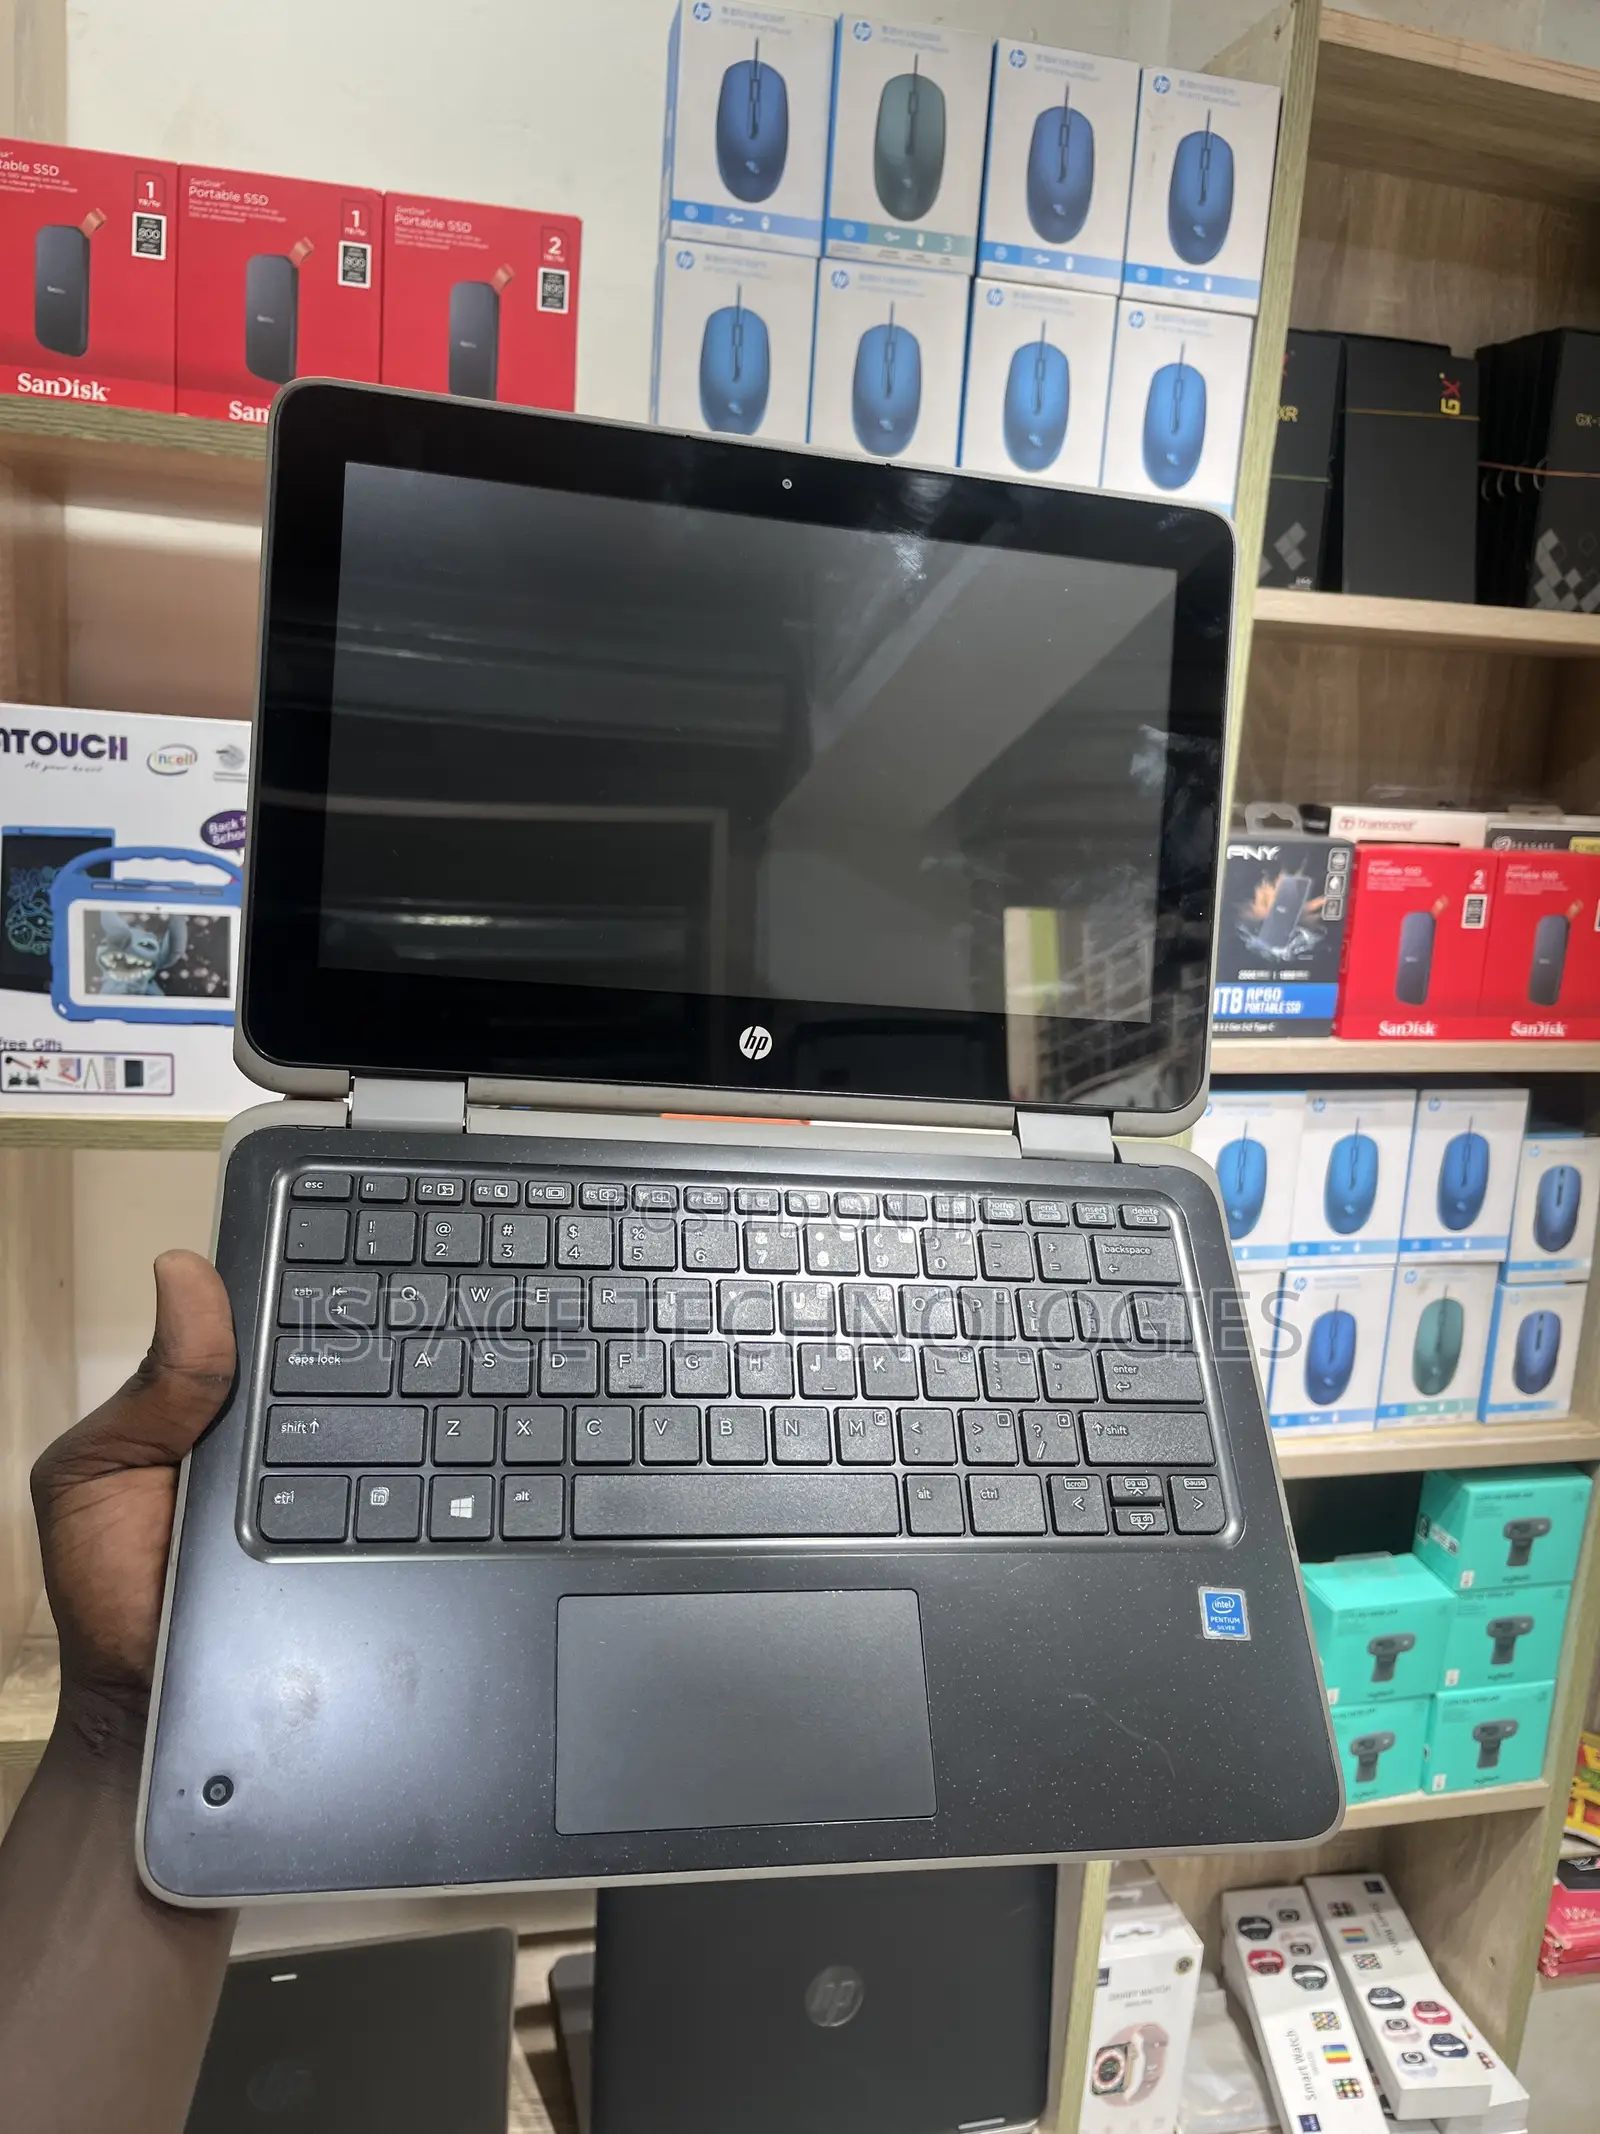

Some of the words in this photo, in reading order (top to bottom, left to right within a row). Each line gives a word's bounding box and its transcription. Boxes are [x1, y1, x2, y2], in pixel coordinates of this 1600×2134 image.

[33, 163, 60, 177] SSD
[145, 181, 155, 199] 1
[188, 186, 241, 201] Portable
[243, 193, 269, 206] SSD
[351, 210, 361, 228] 1
[394, 213, 445, 230] Portable
[447, 220, 471, 233] SSD
[548, 236, 562, 255] 2
[17, 372, 110, 402] SanDisk
[209, 819, 238, 835] Back
[1227, 845, 1280, 861] PNY
[1378, 1020, 1437, 1037] SanDisk
[1510, 1021, 1567, 1037] SanDisk
[739, 1025, 772, 1060] hp
[305, 1181, 323, 1189] esc
[422, 1185, 433, 1194] f2
[477, 1186, 489, 1195] f3
[532, 1188, 543, 1198] f4
[1081, 1206, 1107, 1214] insert
[1132, 1207, 1159, 1216] delete
[435, 1222, 452, 1236] @
[502, 1224, 514, 1236] #
[567, 1224, 579, 1239] $
[632, 1227, 645, 1240] %
[368, 1242, 376, 1255] 1
[435, 1243, 447, 1256] 2
[502, 1244, 514, 1258] 3
[568, 1246, 580, 1259] 4
[633, 1247, 643, 1260] 5
[695, 1249, 706, 1262] 6
[1103, 1245, 1151, 1256] backspace
[294, 1288, 312, 1297] tab
[401, 1287, 417, 1301] Q
[471, 1288, 490, 1302] W
[537, 1289, 549, 1303] E
[602, 1290, 616, 1303] R
[666, 1291, 678, 1304] T
[972, 1299, 982, 1313] P
[288, 1356, 314, 1366] caps
[317, 1354, 341, 1364] lock
[414, 1354, 431, 1368] A
[483, 1353, 497, 1368] S
[552, 1354, 566, 1368] D
[619, 1354, 631, 1369] F
[685, 1355, 700, 1369] G
[749, 1354, 763, 1371] H
[809, 1355, 822, 1372] J
[873, 1356, 887, 1373] K
[933, 1358, 945, 1374] L
[1113, 1365, 1138, 1374] enter
[281, 1422, 307, 1433] shift
[446, 1420, 460, 1436] Z
[516, 1420, 531, 1435] X
[586, 1420, 600, 1435] C
[654, 1420, 668, 1435] V
[720, 1420, 733, 1435] B
[784, 1420, 799, 1436] N
[850, 1420, 865, 1436] M
[1033, 1424, 1042, 1437] ?
[1106, 1425, 1128, 1436] shift
[1066, 1480, 1086, 1488] scroll
[274, 1491, 295, 1504] ctrl
[517, 1491, 530, 1501] alt
[917, 1488, 931, 1499] alt
[981, 1489, 999, 1499] ctrl
[1215, 1600, 1233, 1608] intel
[1210, 1616, 1240, 1624] PENTIUM
[806, 1966, 864, 2027] hp
[1285, 2029, 1305, 2064] Watch
[1298, 2066, 1317, 2101] Smart
